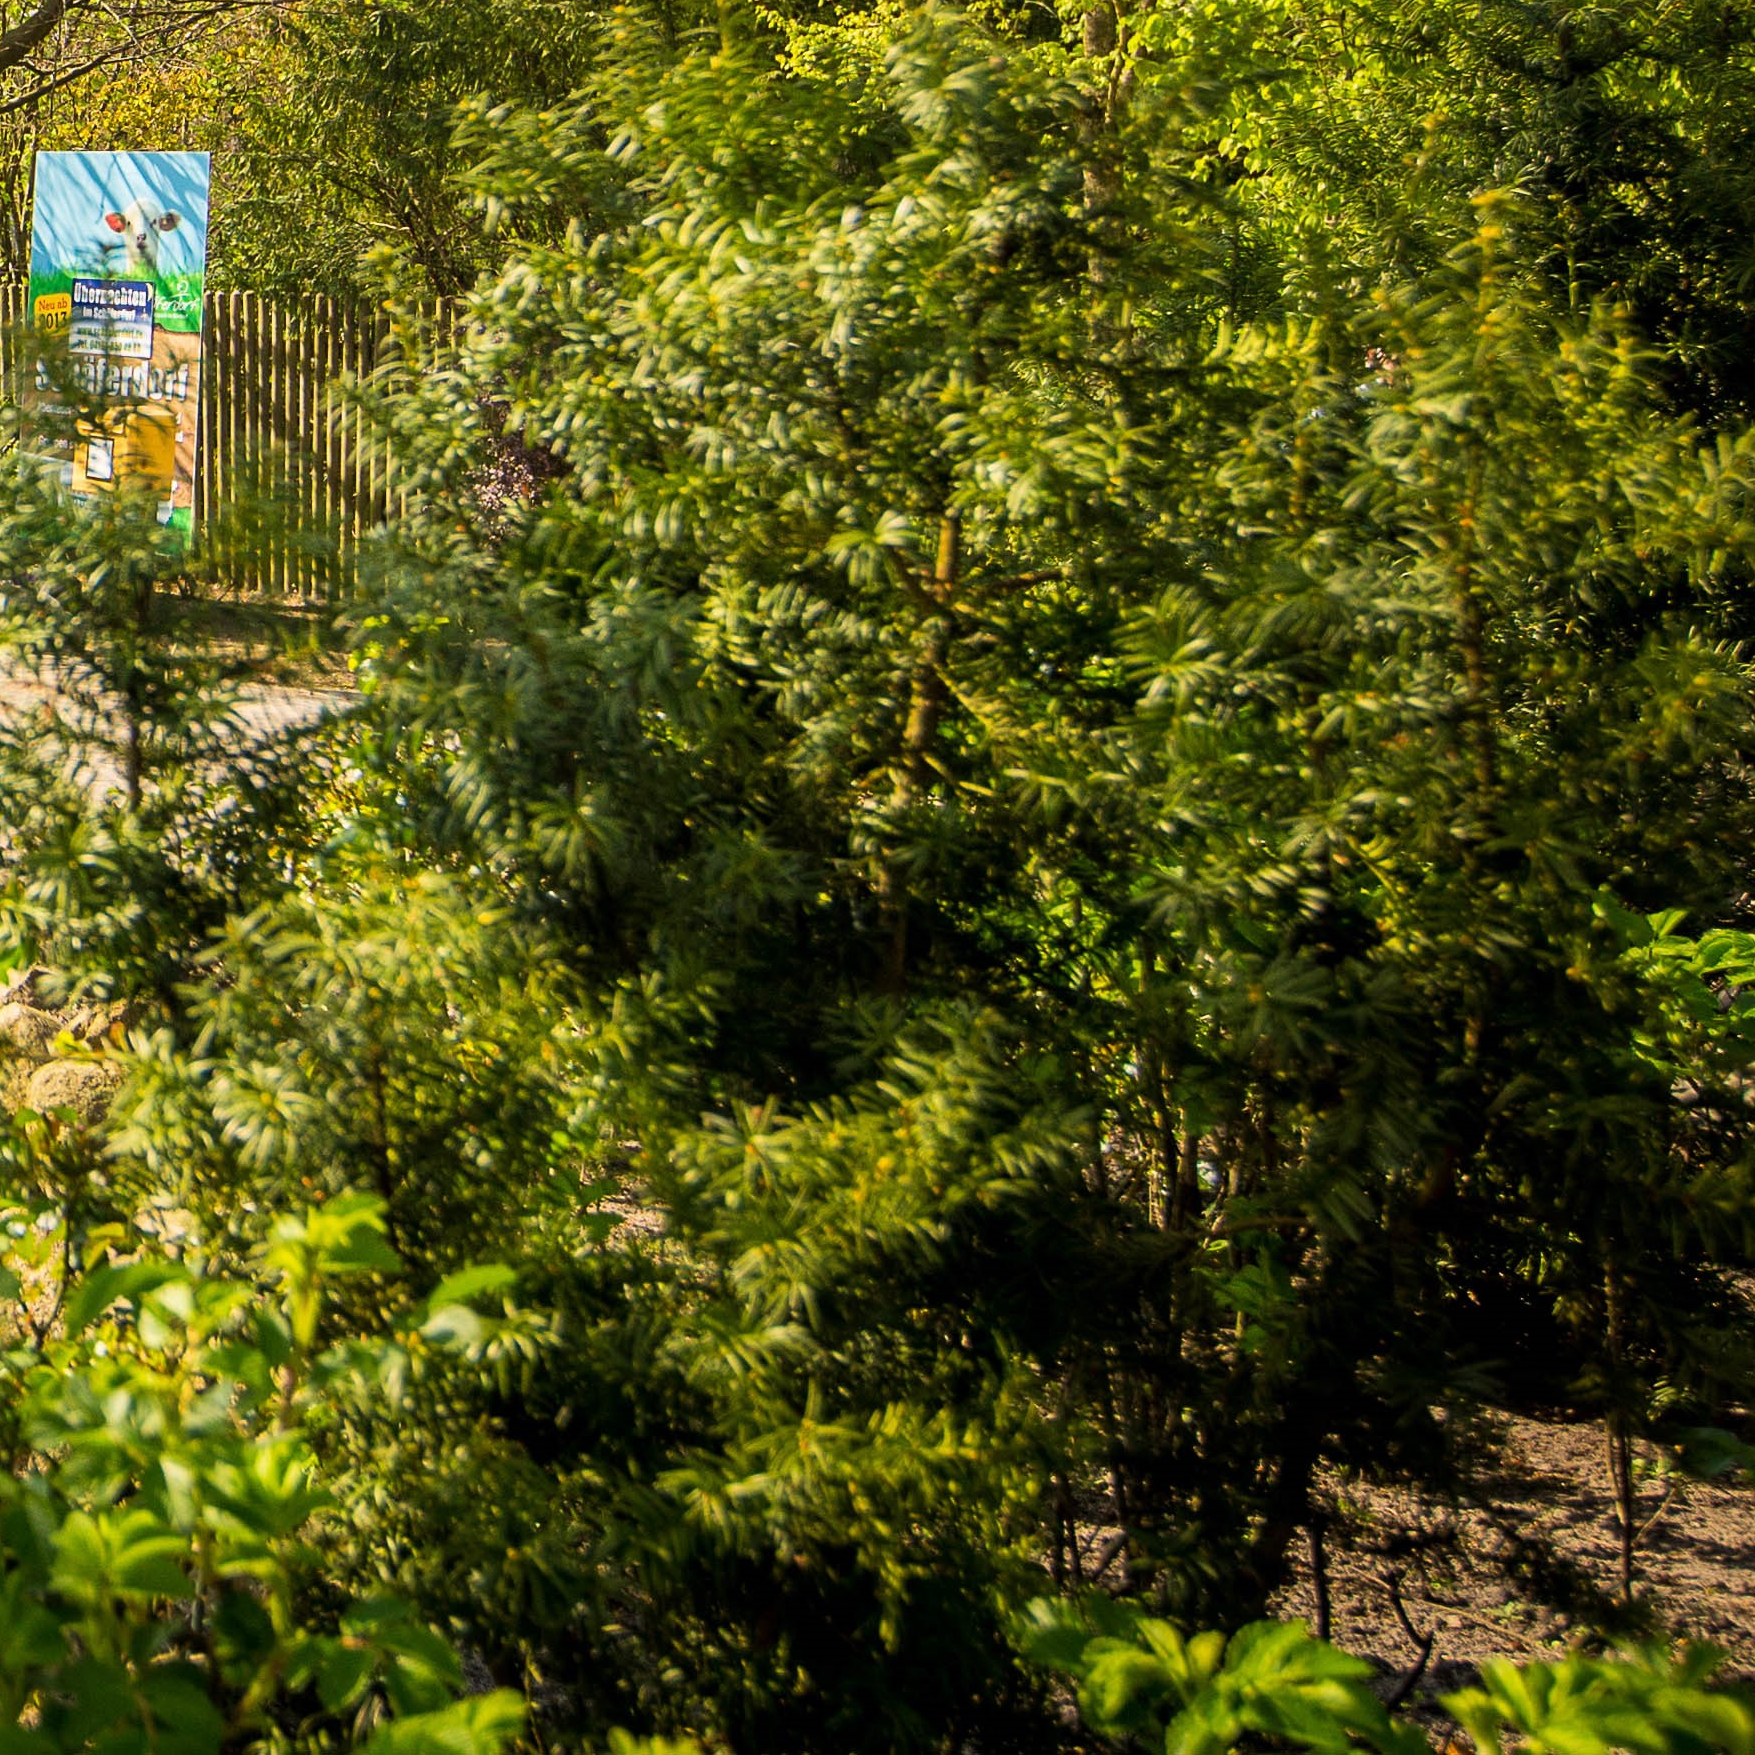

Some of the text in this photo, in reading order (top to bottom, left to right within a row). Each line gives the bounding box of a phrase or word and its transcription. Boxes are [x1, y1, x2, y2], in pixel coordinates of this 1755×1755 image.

[39, 297, 68, 311] Neu ab
[73, 281, 147, 308] Übernchten
